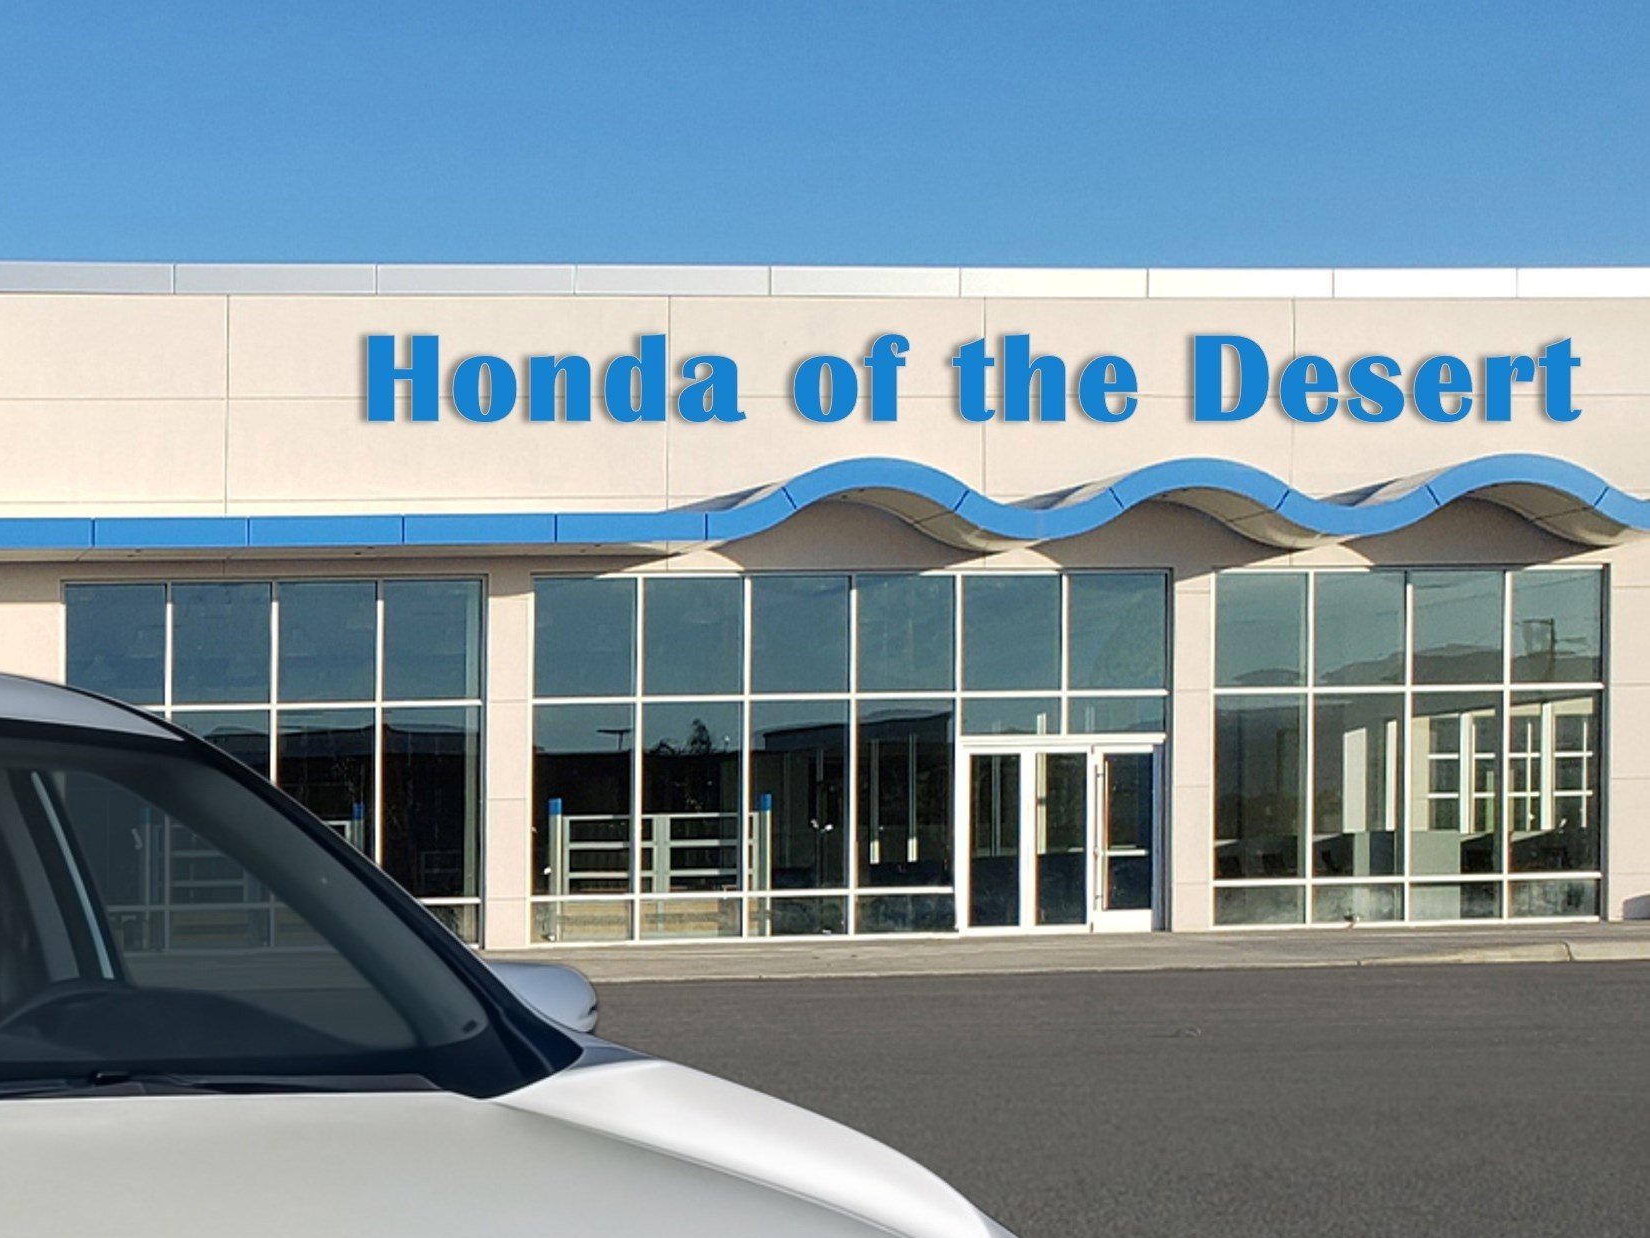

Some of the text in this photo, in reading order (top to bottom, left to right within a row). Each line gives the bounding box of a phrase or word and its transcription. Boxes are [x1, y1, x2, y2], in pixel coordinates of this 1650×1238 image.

[365, 332, 1583, 425] Honda of the Desert
